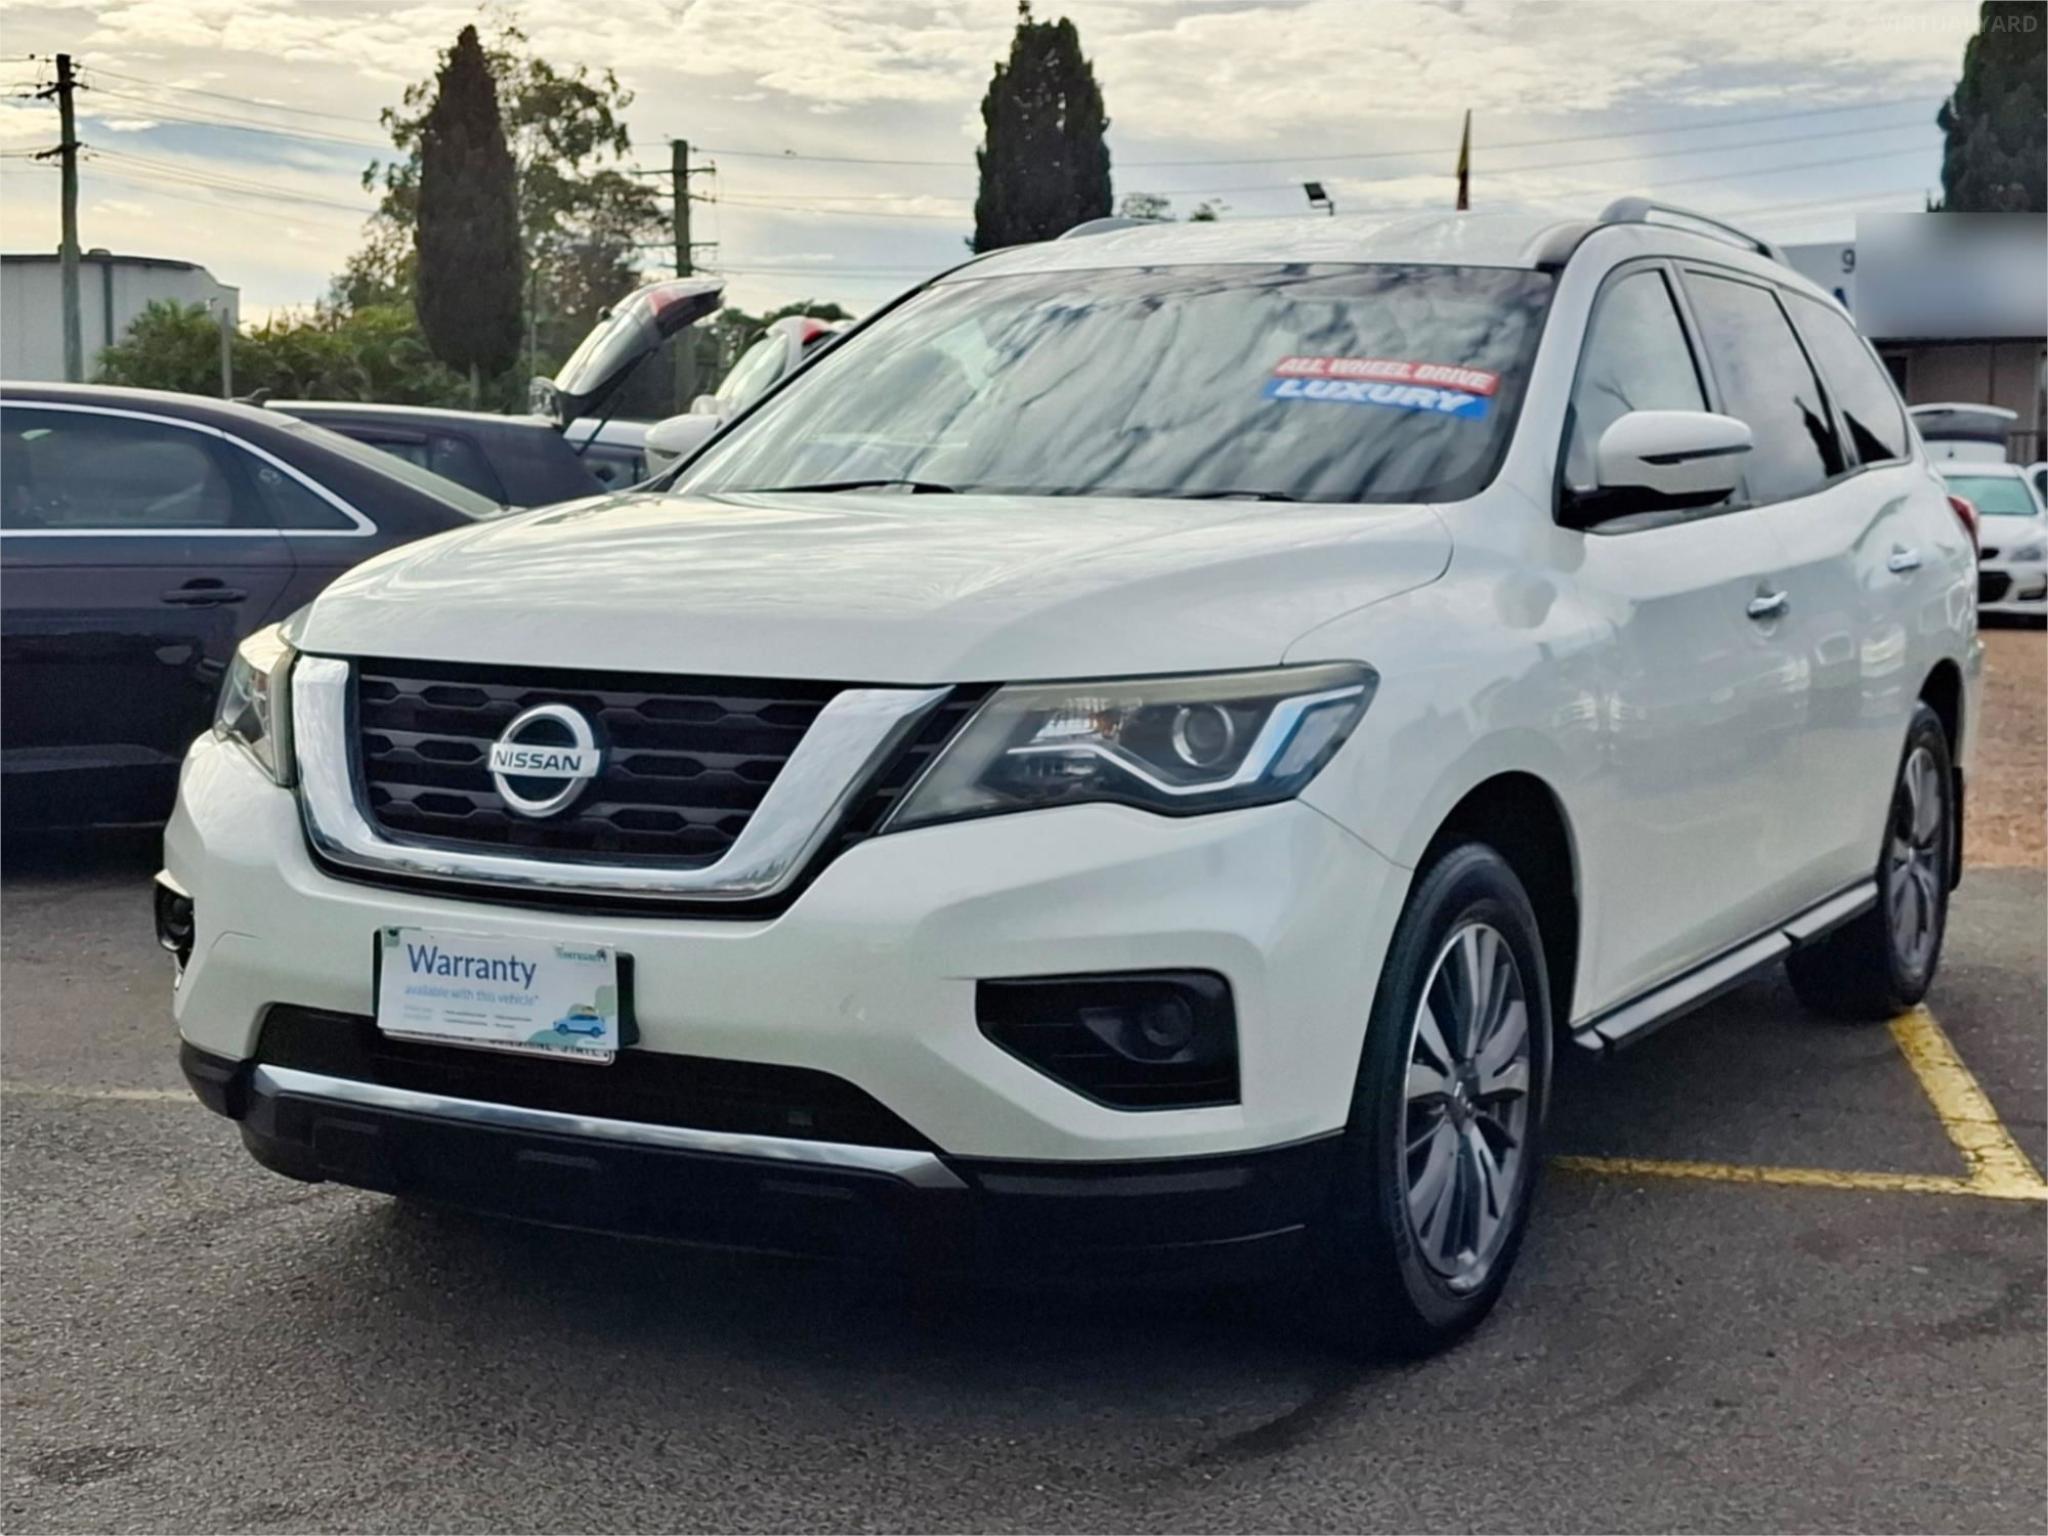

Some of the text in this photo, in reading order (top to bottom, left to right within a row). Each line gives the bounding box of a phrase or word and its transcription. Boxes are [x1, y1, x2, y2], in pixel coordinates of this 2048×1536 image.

[1276, 358, 1494, 389] ALL WHEEL DRIVE
[1274, 379, 1477, 412] LUXURY
[494, 750, 582, 771] NISSAN
[407, 944, 537, 989] Warranty
[404, 984, 448, 999] available
[450, 988, 475, 1002] with
[476, 991, 497, 1004] this
